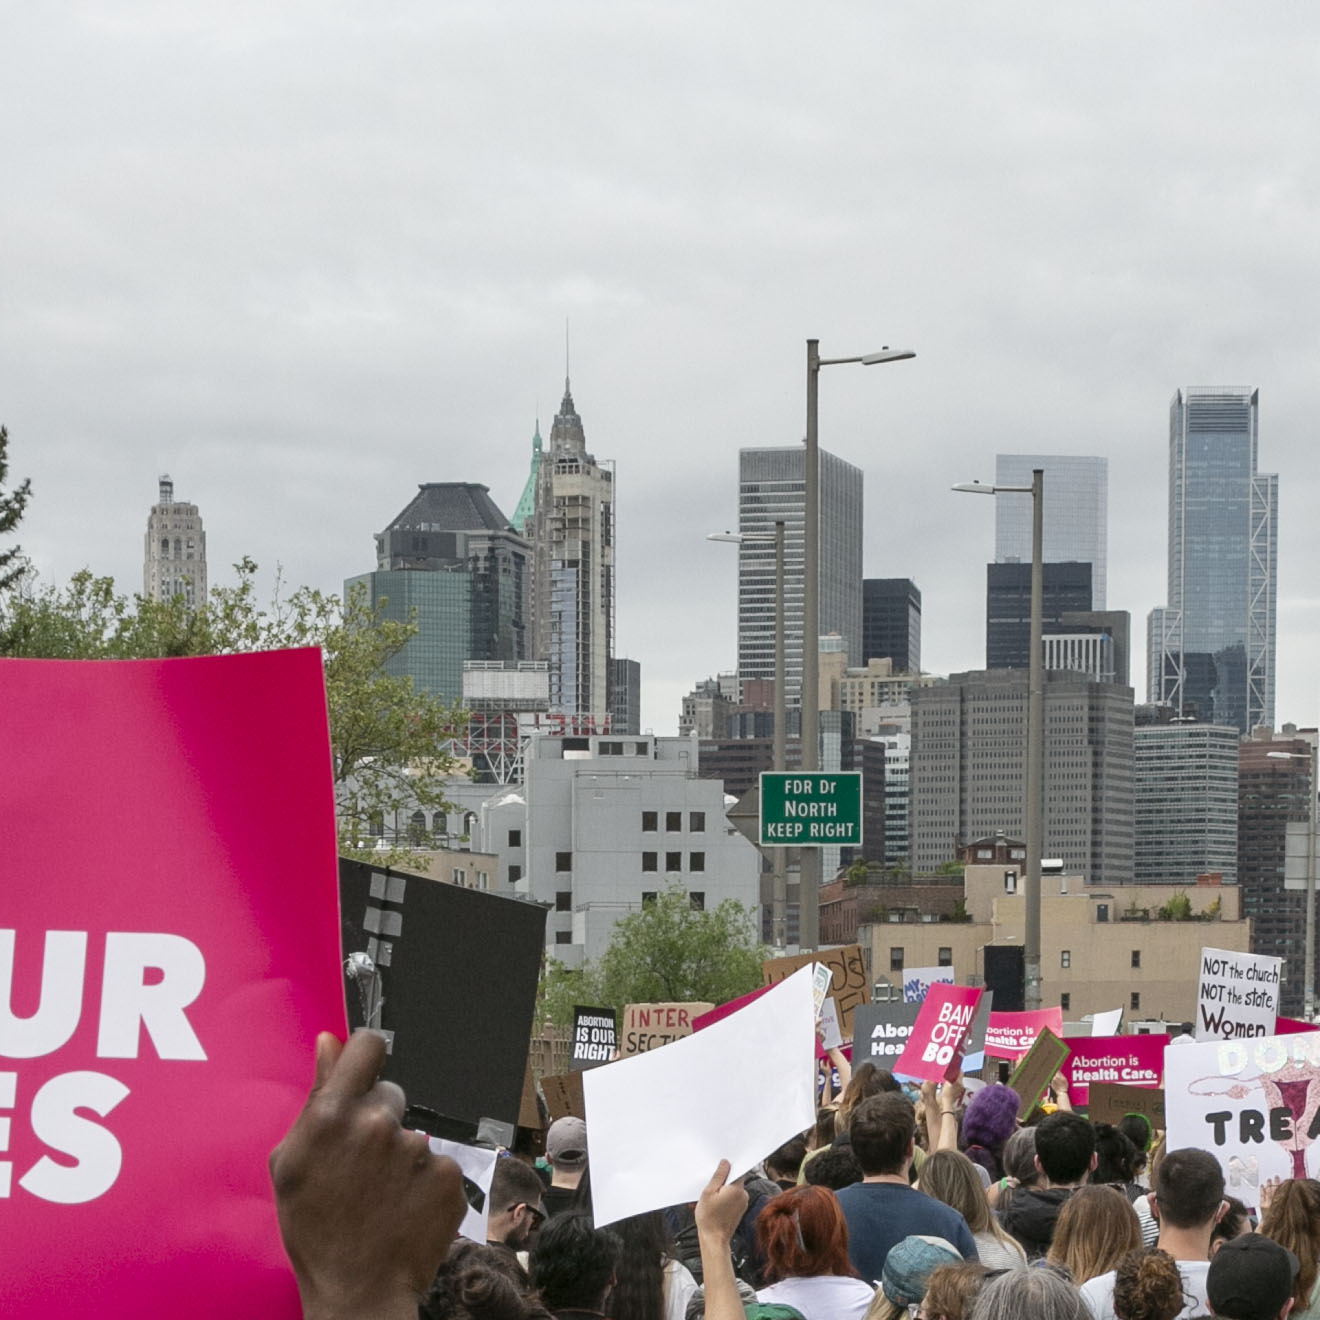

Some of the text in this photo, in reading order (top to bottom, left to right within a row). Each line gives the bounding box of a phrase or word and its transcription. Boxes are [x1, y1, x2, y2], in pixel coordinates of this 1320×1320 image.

[784, 780, 836, 794] FDR Dr
[784, 800, 837, 817] NORTH
[767, 822, 854, 837] KEEP RIGHT
[1203, 957, 1278, 984] NOT the church
[1201, 982, 1274, 1011] NOT the state,
[577, 1015, 614, 1028] ABORTION
[1201, 1003, 1266, 1040] Women
[576, 1027, 615, 1044] IS OUR
[931, 1023, 965, 1046] OFF
[1025, 1025, 1034, 1036] is
[574, 1043, 616, 1061] RIGHT
[871, 1042, 908, 1055] Hea
[1071, 1054, 1139, 1067] Abortion is
[1072, 1068, 1158, 1081] Health Care.
